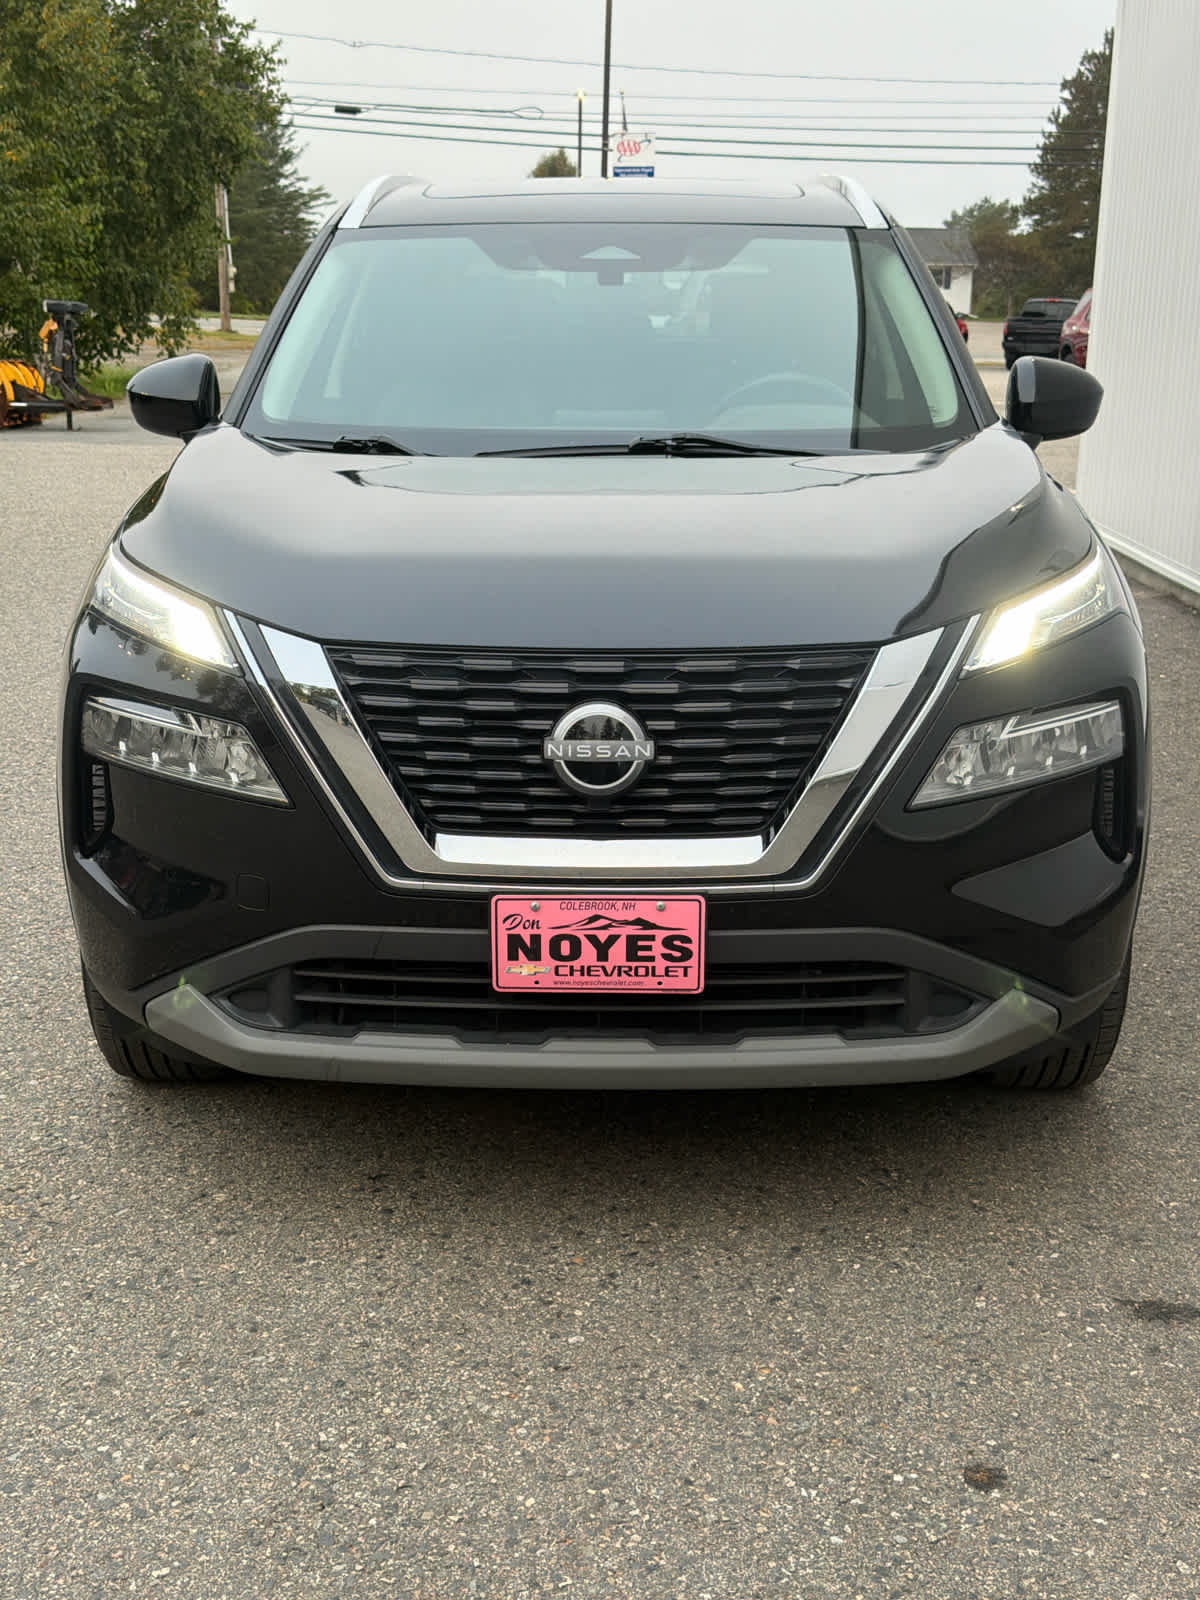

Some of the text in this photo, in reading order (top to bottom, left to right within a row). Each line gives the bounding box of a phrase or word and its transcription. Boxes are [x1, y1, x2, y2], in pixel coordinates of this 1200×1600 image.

[548, 743, 651, 758] NISSAN
[559, 901, 636, 912] COLEBROOK, NH
[502, 913, 541, 931] Don
[507, 933, 693, 963] NOYES
[554, 965, 693, 978] CHEVROLET
